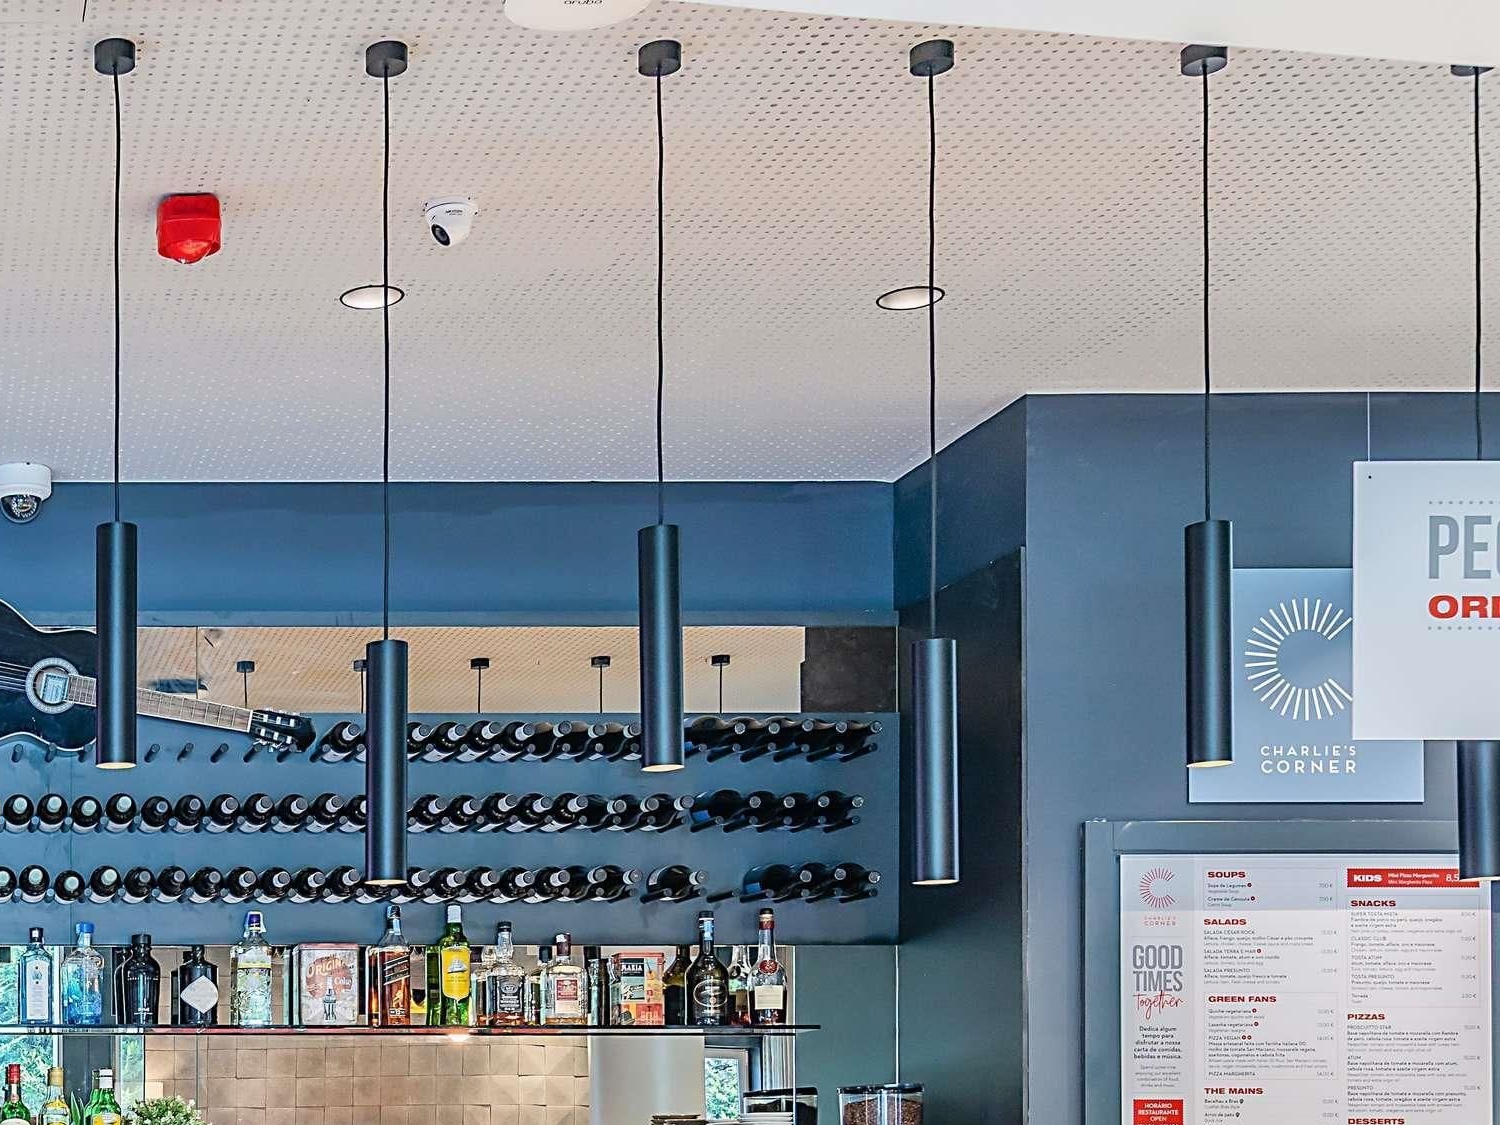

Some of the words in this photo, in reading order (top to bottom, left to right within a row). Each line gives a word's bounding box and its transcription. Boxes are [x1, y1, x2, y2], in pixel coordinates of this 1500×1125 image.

[1260, 745, 1357, 757] CHARLIE'S
[1260, 759, 1357, 774] CORNER
[1207, 871, 1246, 879] SOUPS
[1353, 874, 1382, 882] KIDS
[1204, 918, 1247, 926] SALADS
[1132, 944, 1183, 969] GOOD
[1132, 970, 1183, 992] TIMES
